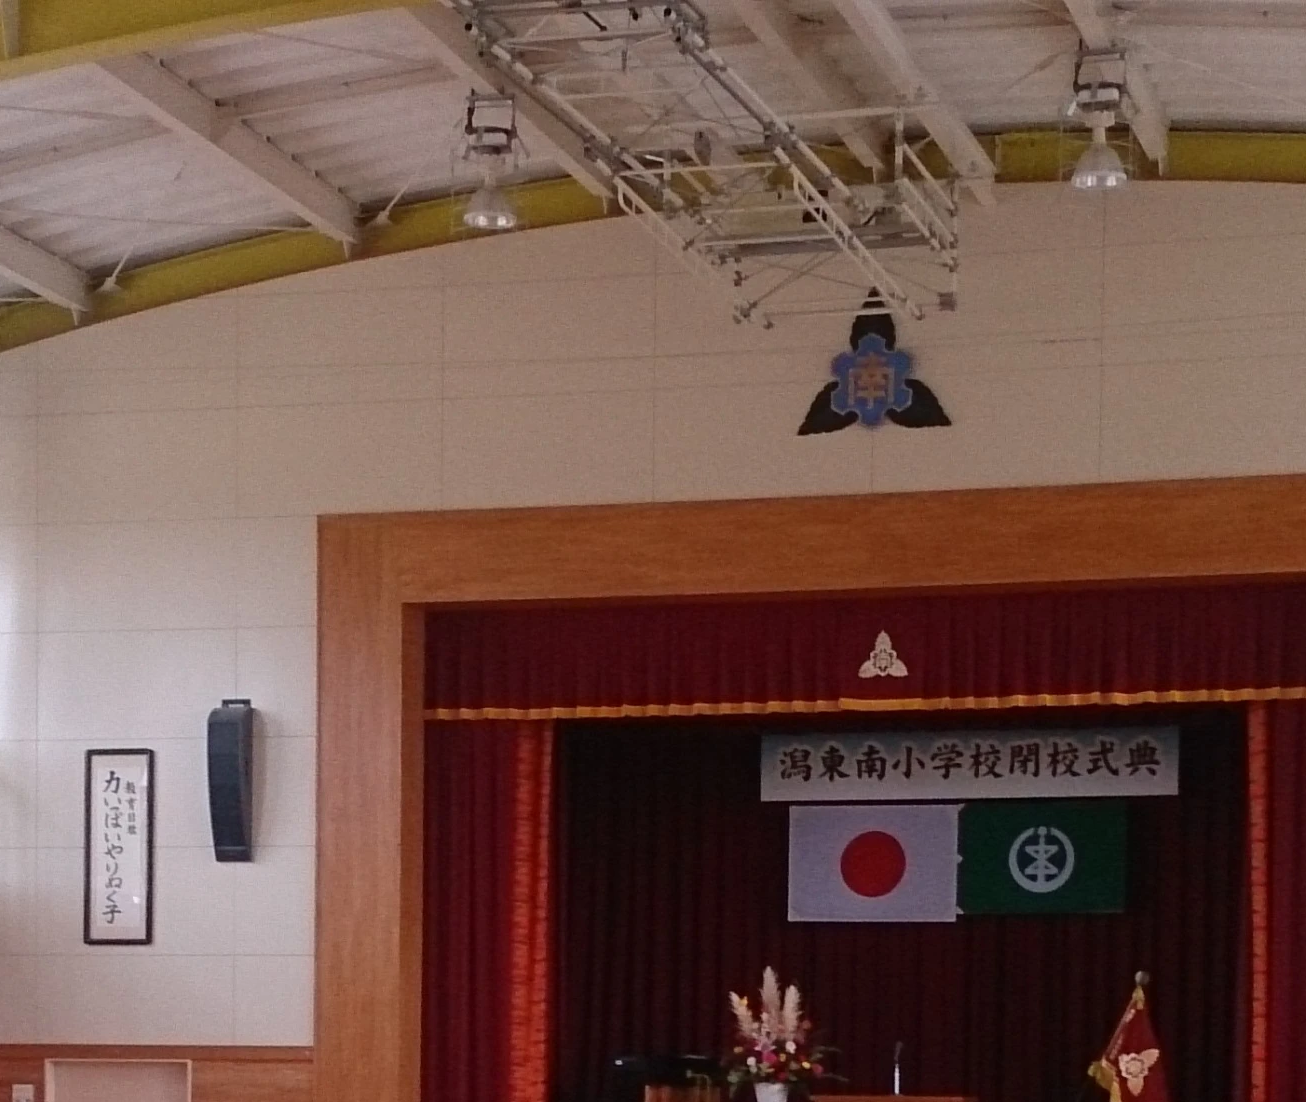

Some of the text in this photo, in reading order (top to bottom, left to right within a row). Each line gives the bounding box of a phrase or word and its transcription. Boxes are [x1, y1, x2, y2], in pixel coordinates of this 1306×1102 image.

[779, 738, 1162, 782] 潟東南小学校閉校式典
